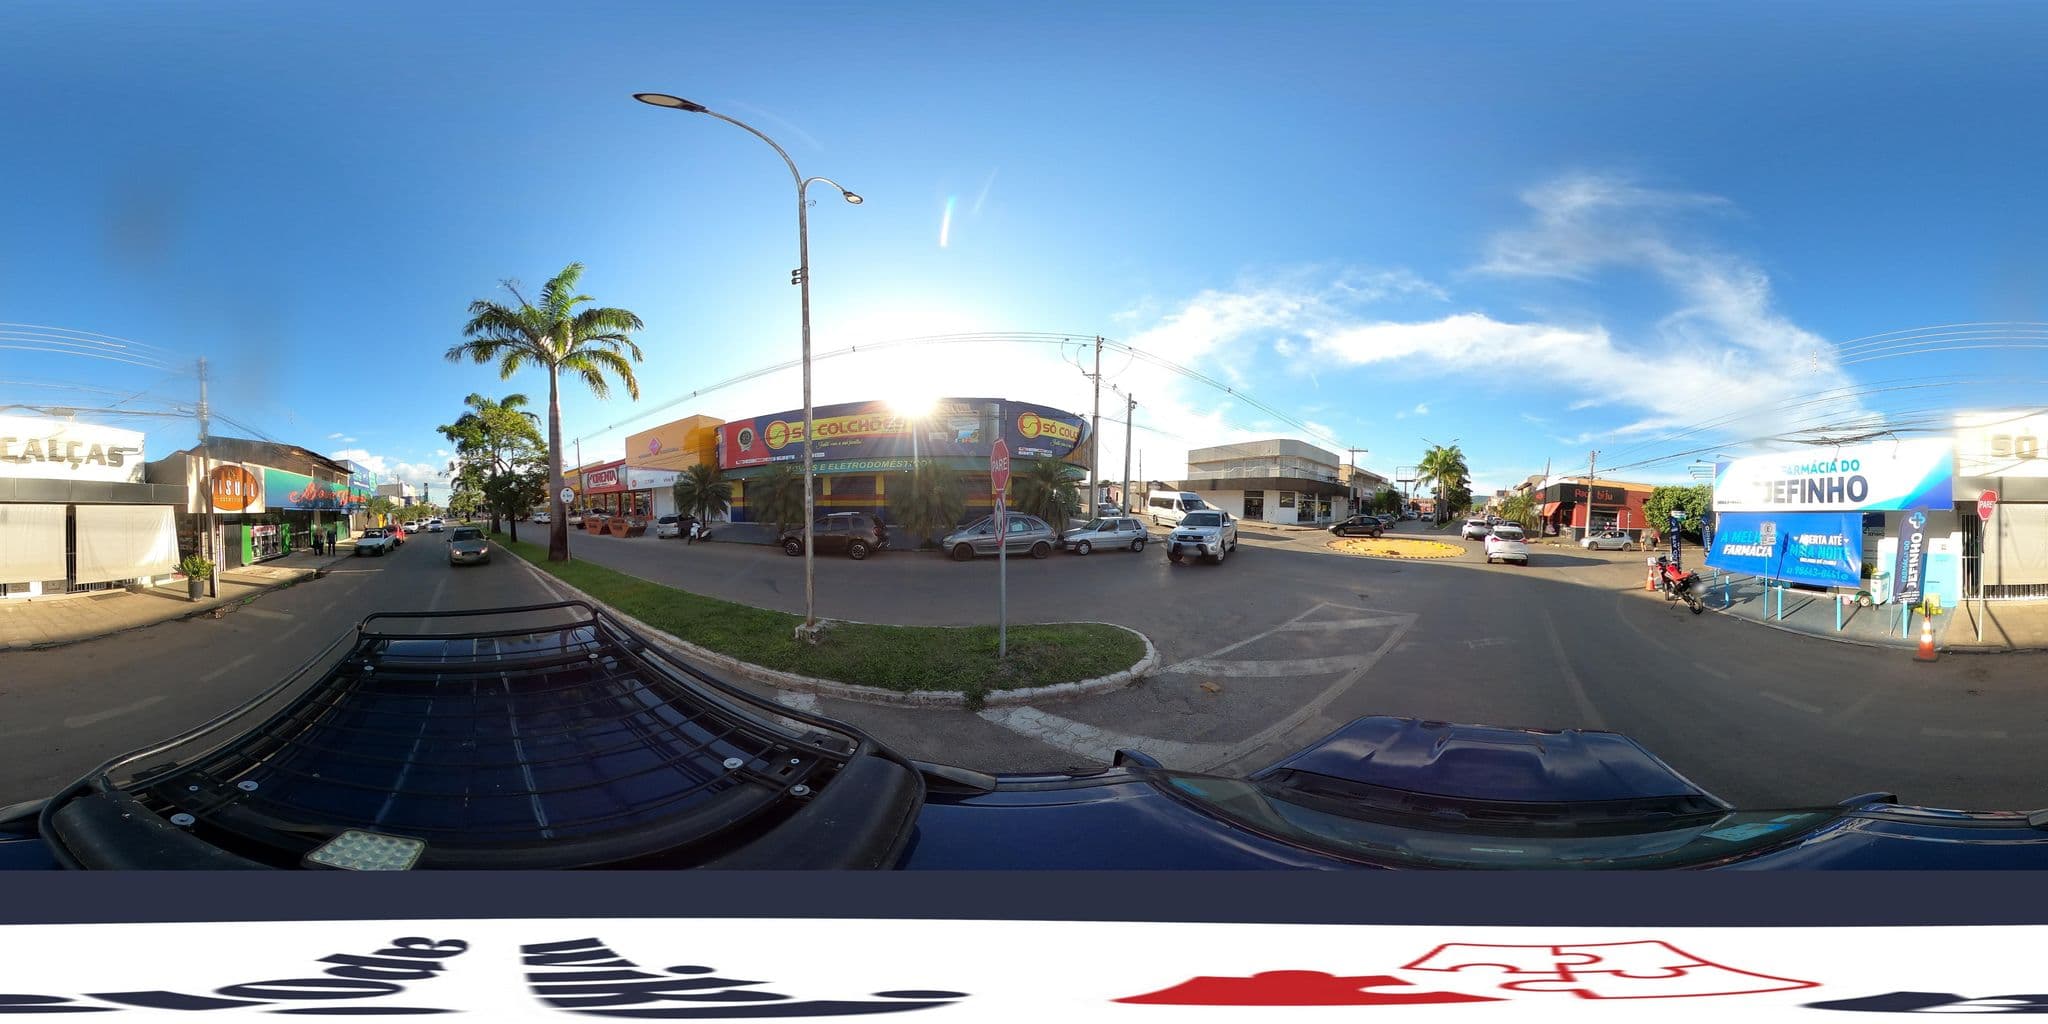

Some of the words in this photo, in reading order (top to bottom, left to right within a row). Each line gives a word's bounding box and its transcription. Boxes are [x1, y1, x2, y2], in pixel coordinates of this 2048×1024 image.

[1043, 422, 1057, 433] SÓ
[1991, 428, 2038, 459] SÓ
[0, 437, 138, 470] CALÇAS
[820, 463, 826, 471] E
[992, 456, 1009, 472] PARE
[1781, 461, 1838, 475] FARMÁCIA
[1841, 459, 1860, 472] DO
[1762, 475, 1868, 504] JEFINHO
[1732, 530, 1778, 544] MELH
[1828, 534, 1843, 546] ATÉ
[1906, 532, 1923, 588] JEFINHO
